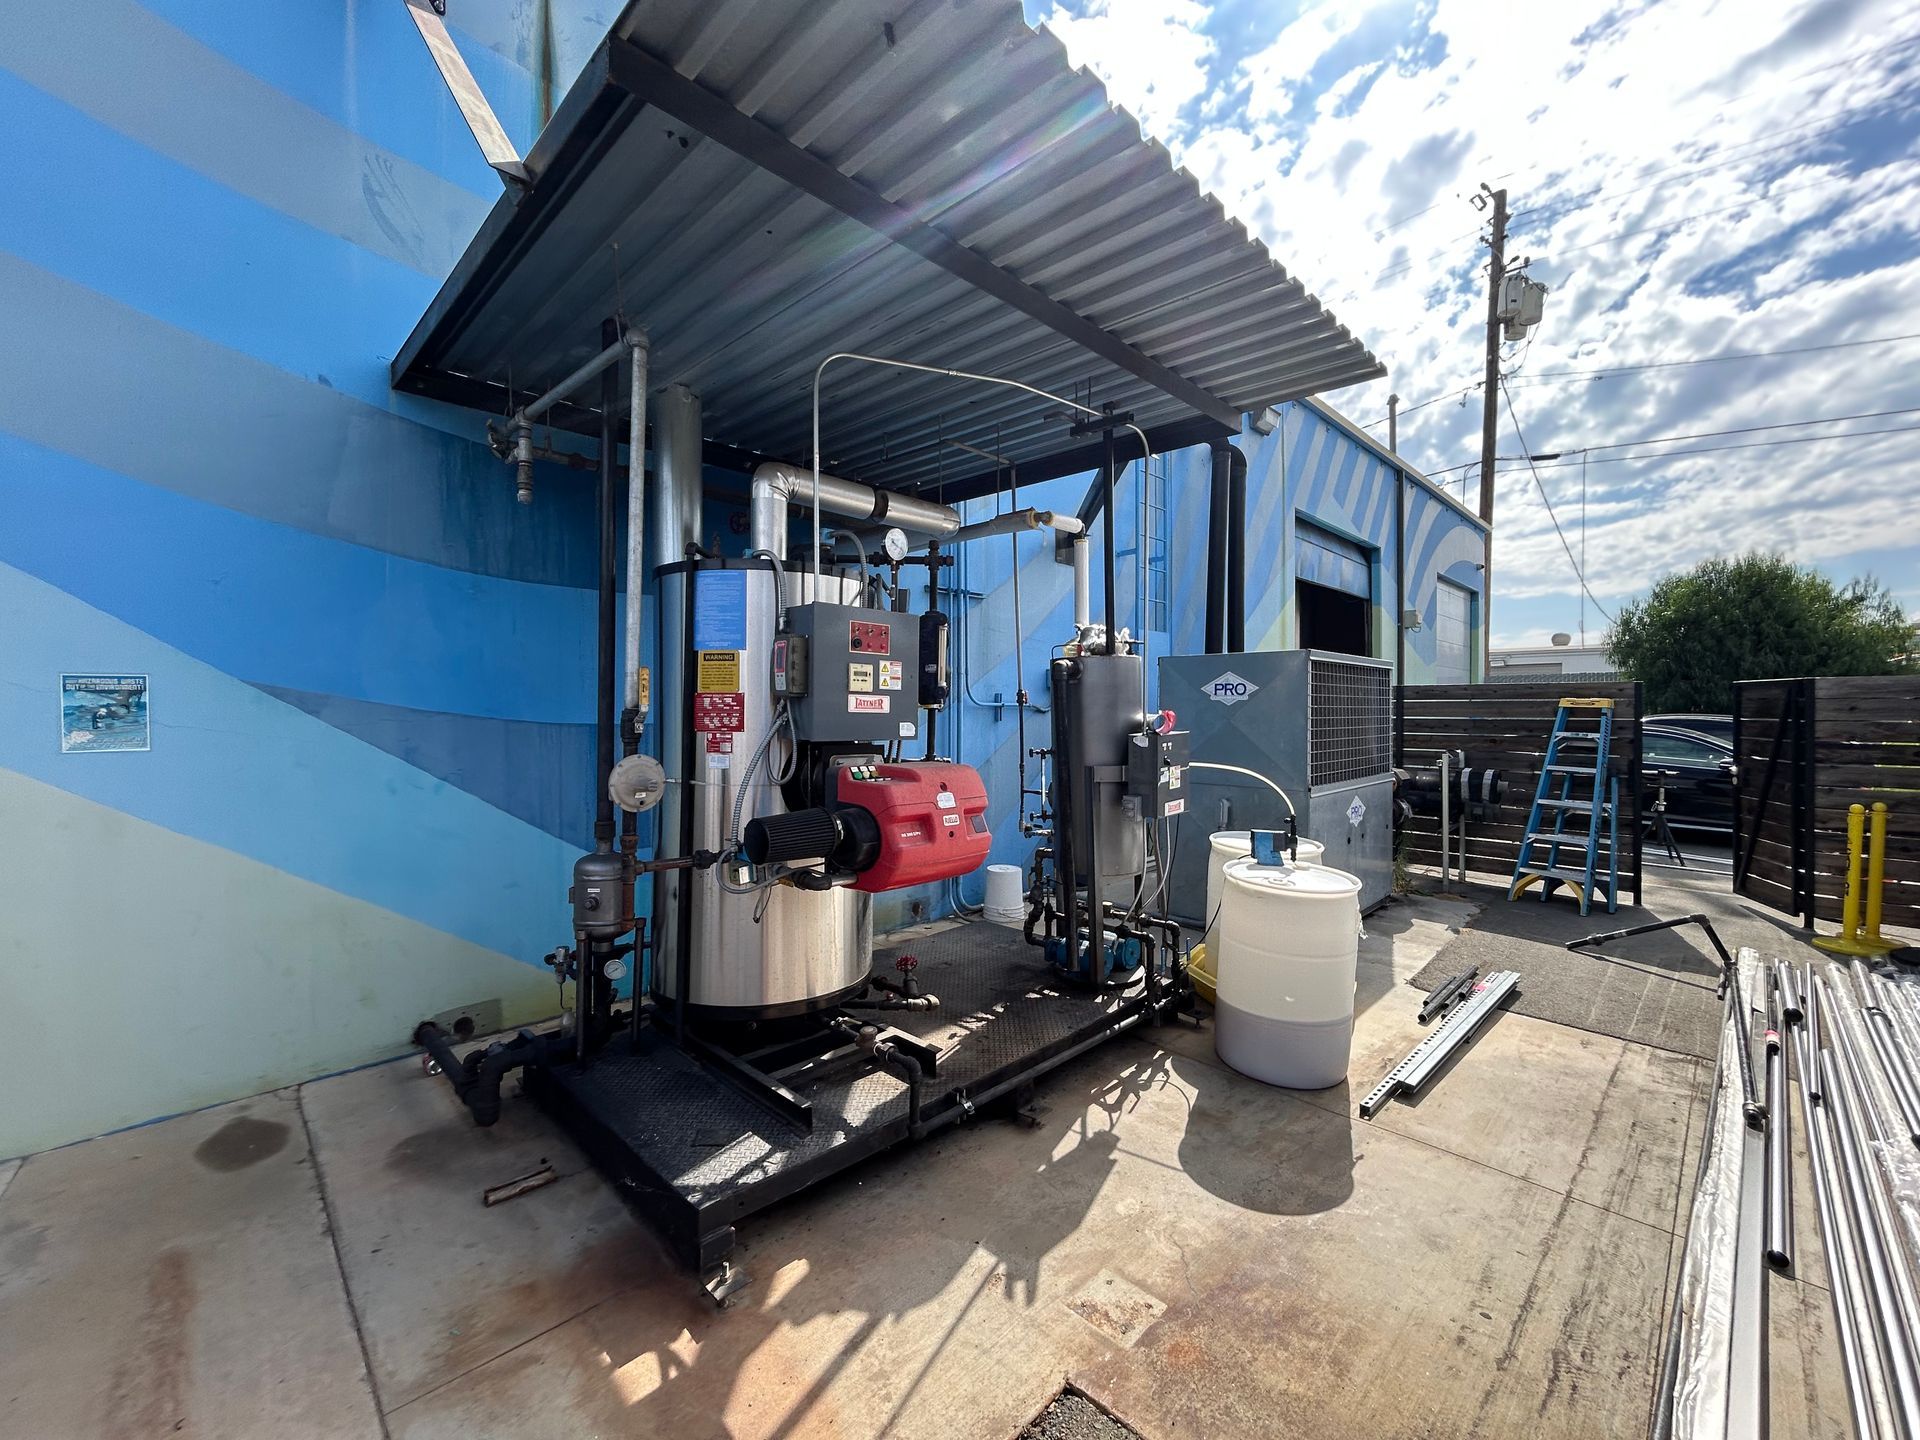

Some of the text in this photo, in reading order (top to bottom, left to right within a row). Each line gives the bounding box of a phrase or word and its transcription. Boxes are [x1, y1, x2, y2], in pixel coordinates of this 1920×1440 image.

[1214, 683, 1247, 695] PRO
[855, 696, 883, 709] LATTNER
[1351, 805, 1363, 818] PRO
